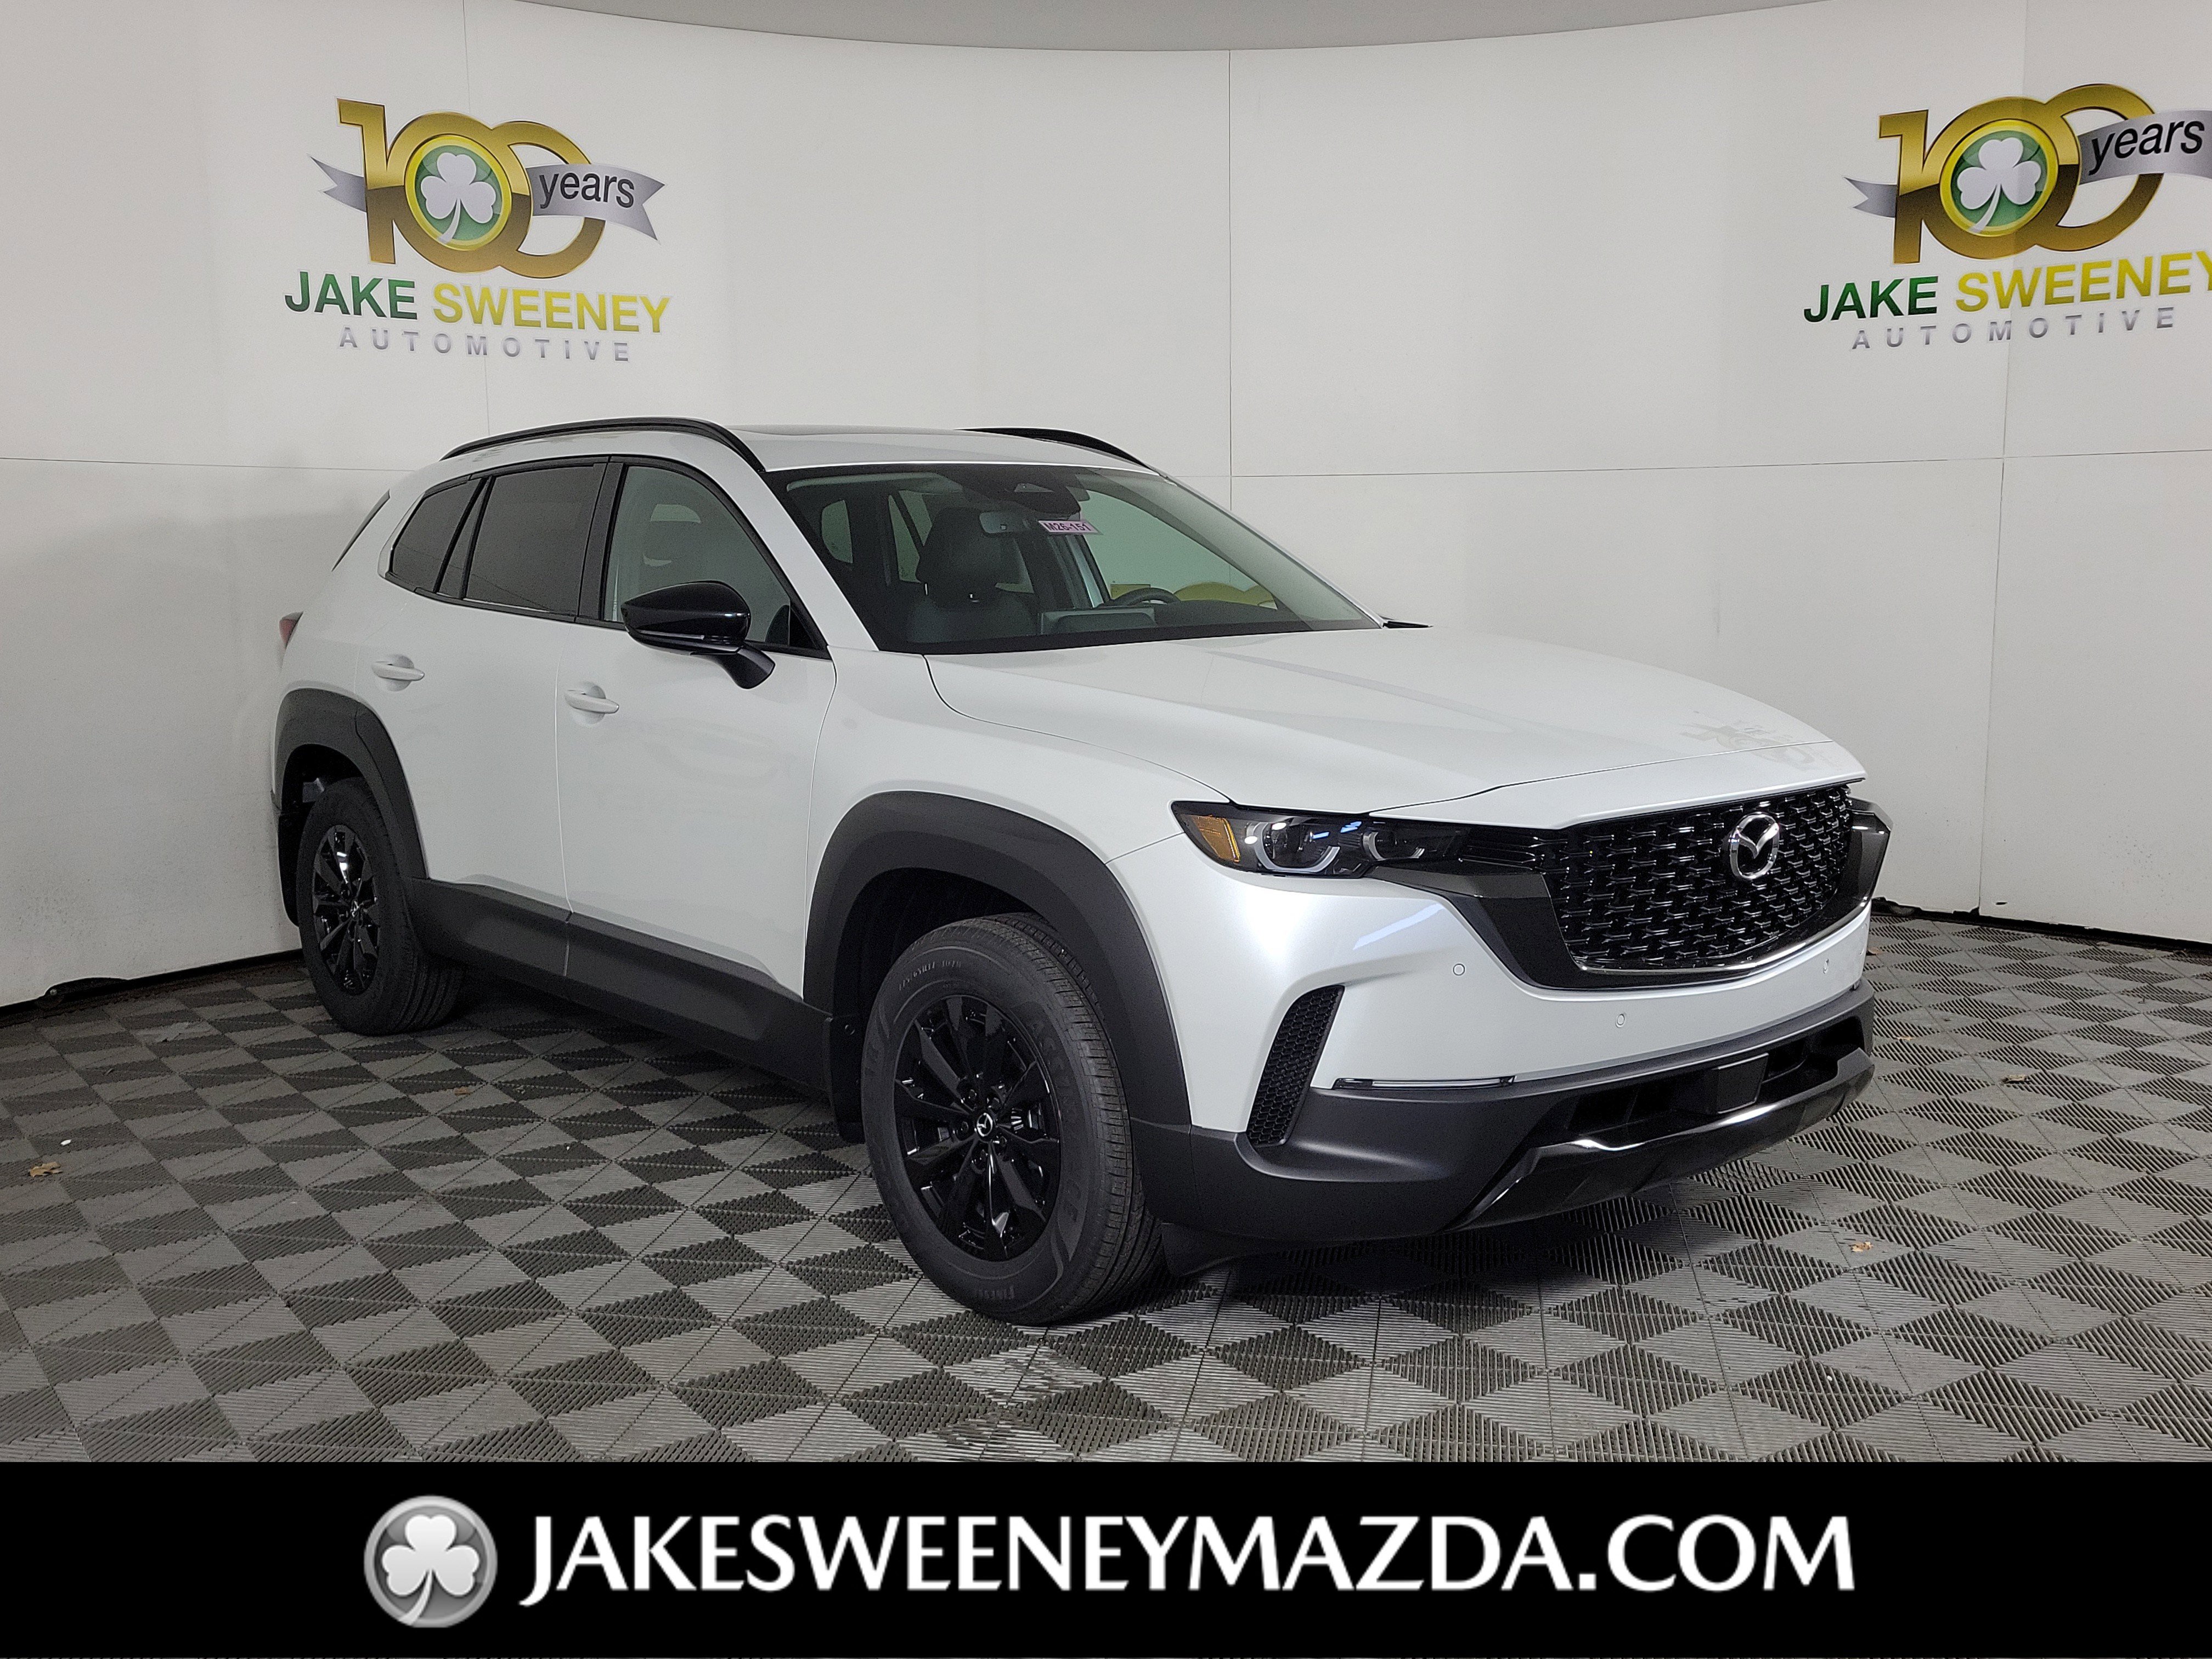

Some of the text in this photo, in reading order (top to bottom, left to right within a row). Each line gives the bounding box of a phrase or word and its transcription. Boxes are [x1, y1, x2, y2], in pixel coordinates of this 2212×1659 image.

[337, 98, 635, 278] 100 years
[1878, 83, 2205, 264] 100 years
[284, 271, 670, 333] JAKE SWEENEY
[1803, 276, 1938, 323] JAKE
[338, 327, 629, 362] AUTOMOTIVE
[1852, 307, 2175, 349] AUTOMOTIVE
[1043, 522, 1092, 532] M26-151
